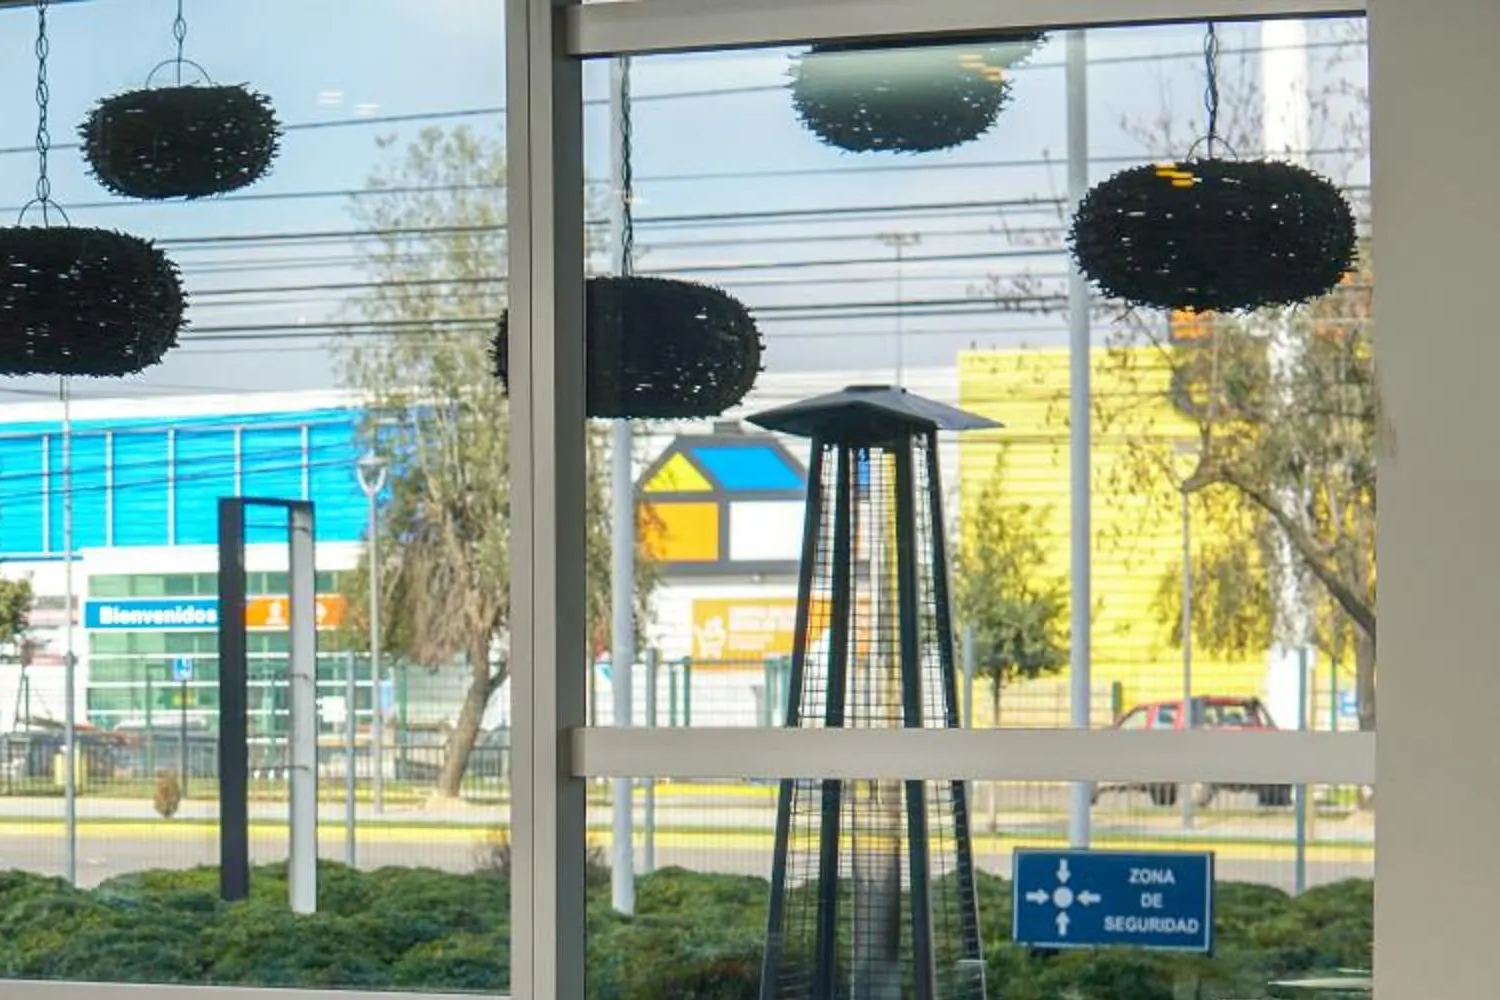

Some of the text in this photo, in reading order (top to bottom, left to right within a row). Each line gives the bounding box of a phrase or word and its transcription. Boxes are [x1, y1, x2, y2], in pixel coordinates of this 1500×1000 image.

[99, 605, 219, 625] Bienvenidos
[1128, 868, 1176, 884] ZONA
[1140, 892, 1164, 909] DE
[1104, 915, 1200, 935] SEGURIDAD
